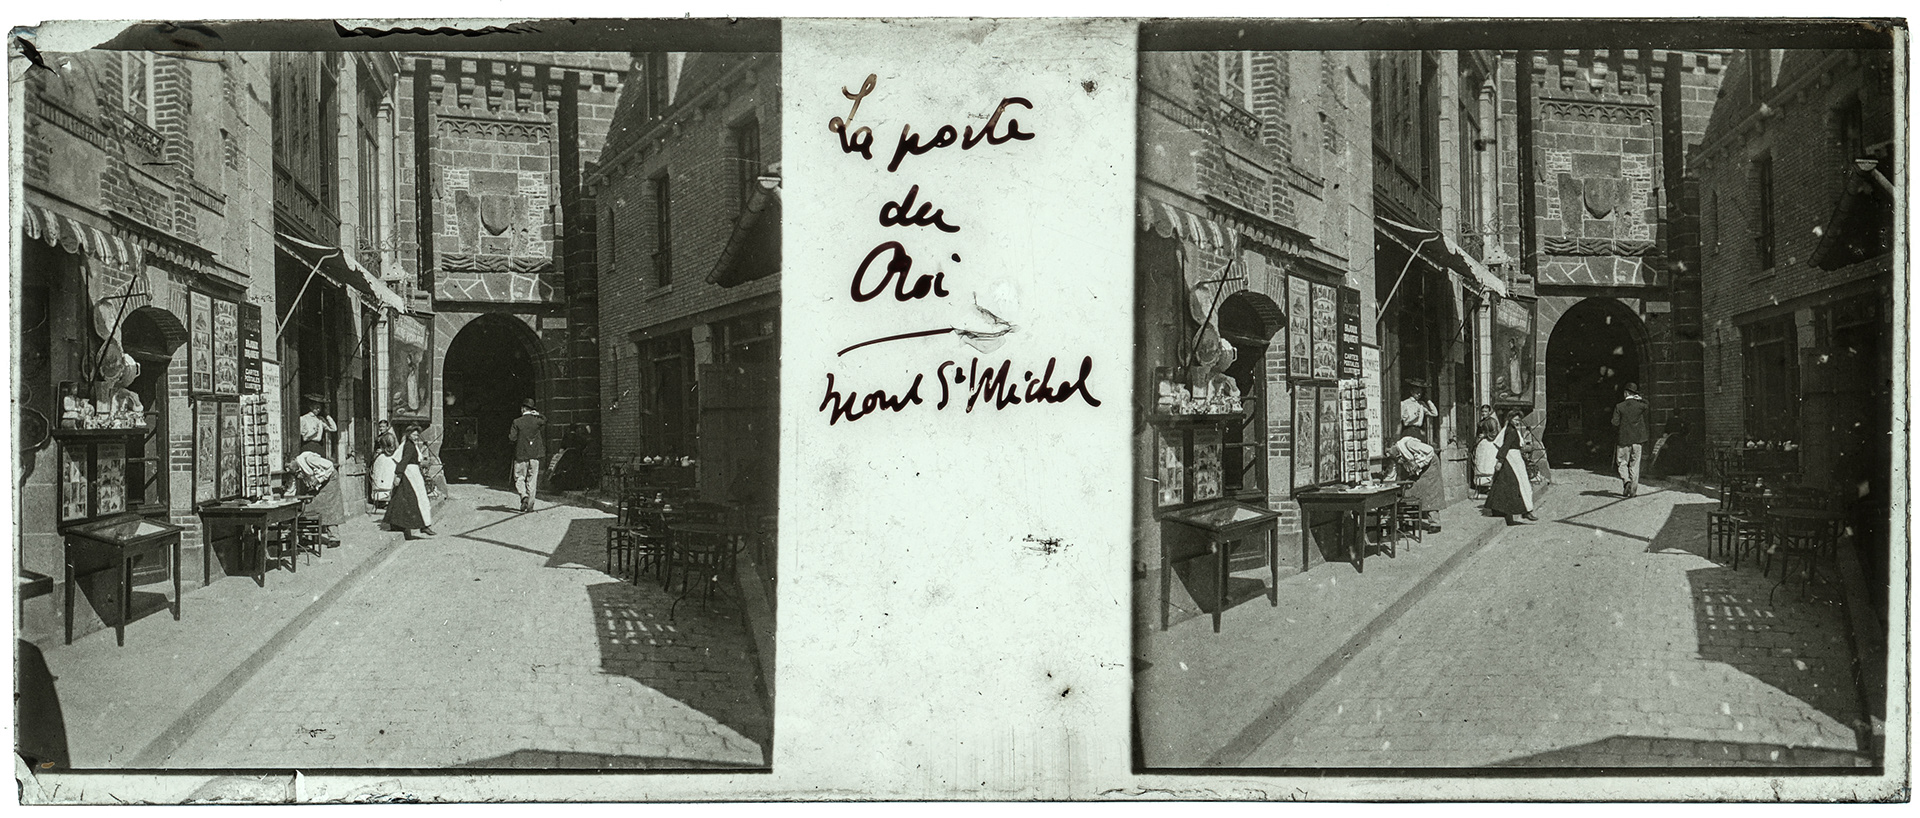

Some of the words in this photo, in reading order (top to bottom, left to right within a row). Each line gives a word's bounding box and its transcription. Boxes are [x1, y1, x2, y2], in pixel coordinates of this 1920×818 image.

[828, 73, 878, 160] La
[887, 96, 1036, 172] porte
[879, 184, 961, 233] du
[850, 240, 962, 303] Roi
[965, 355, 1102, 414] Michel
